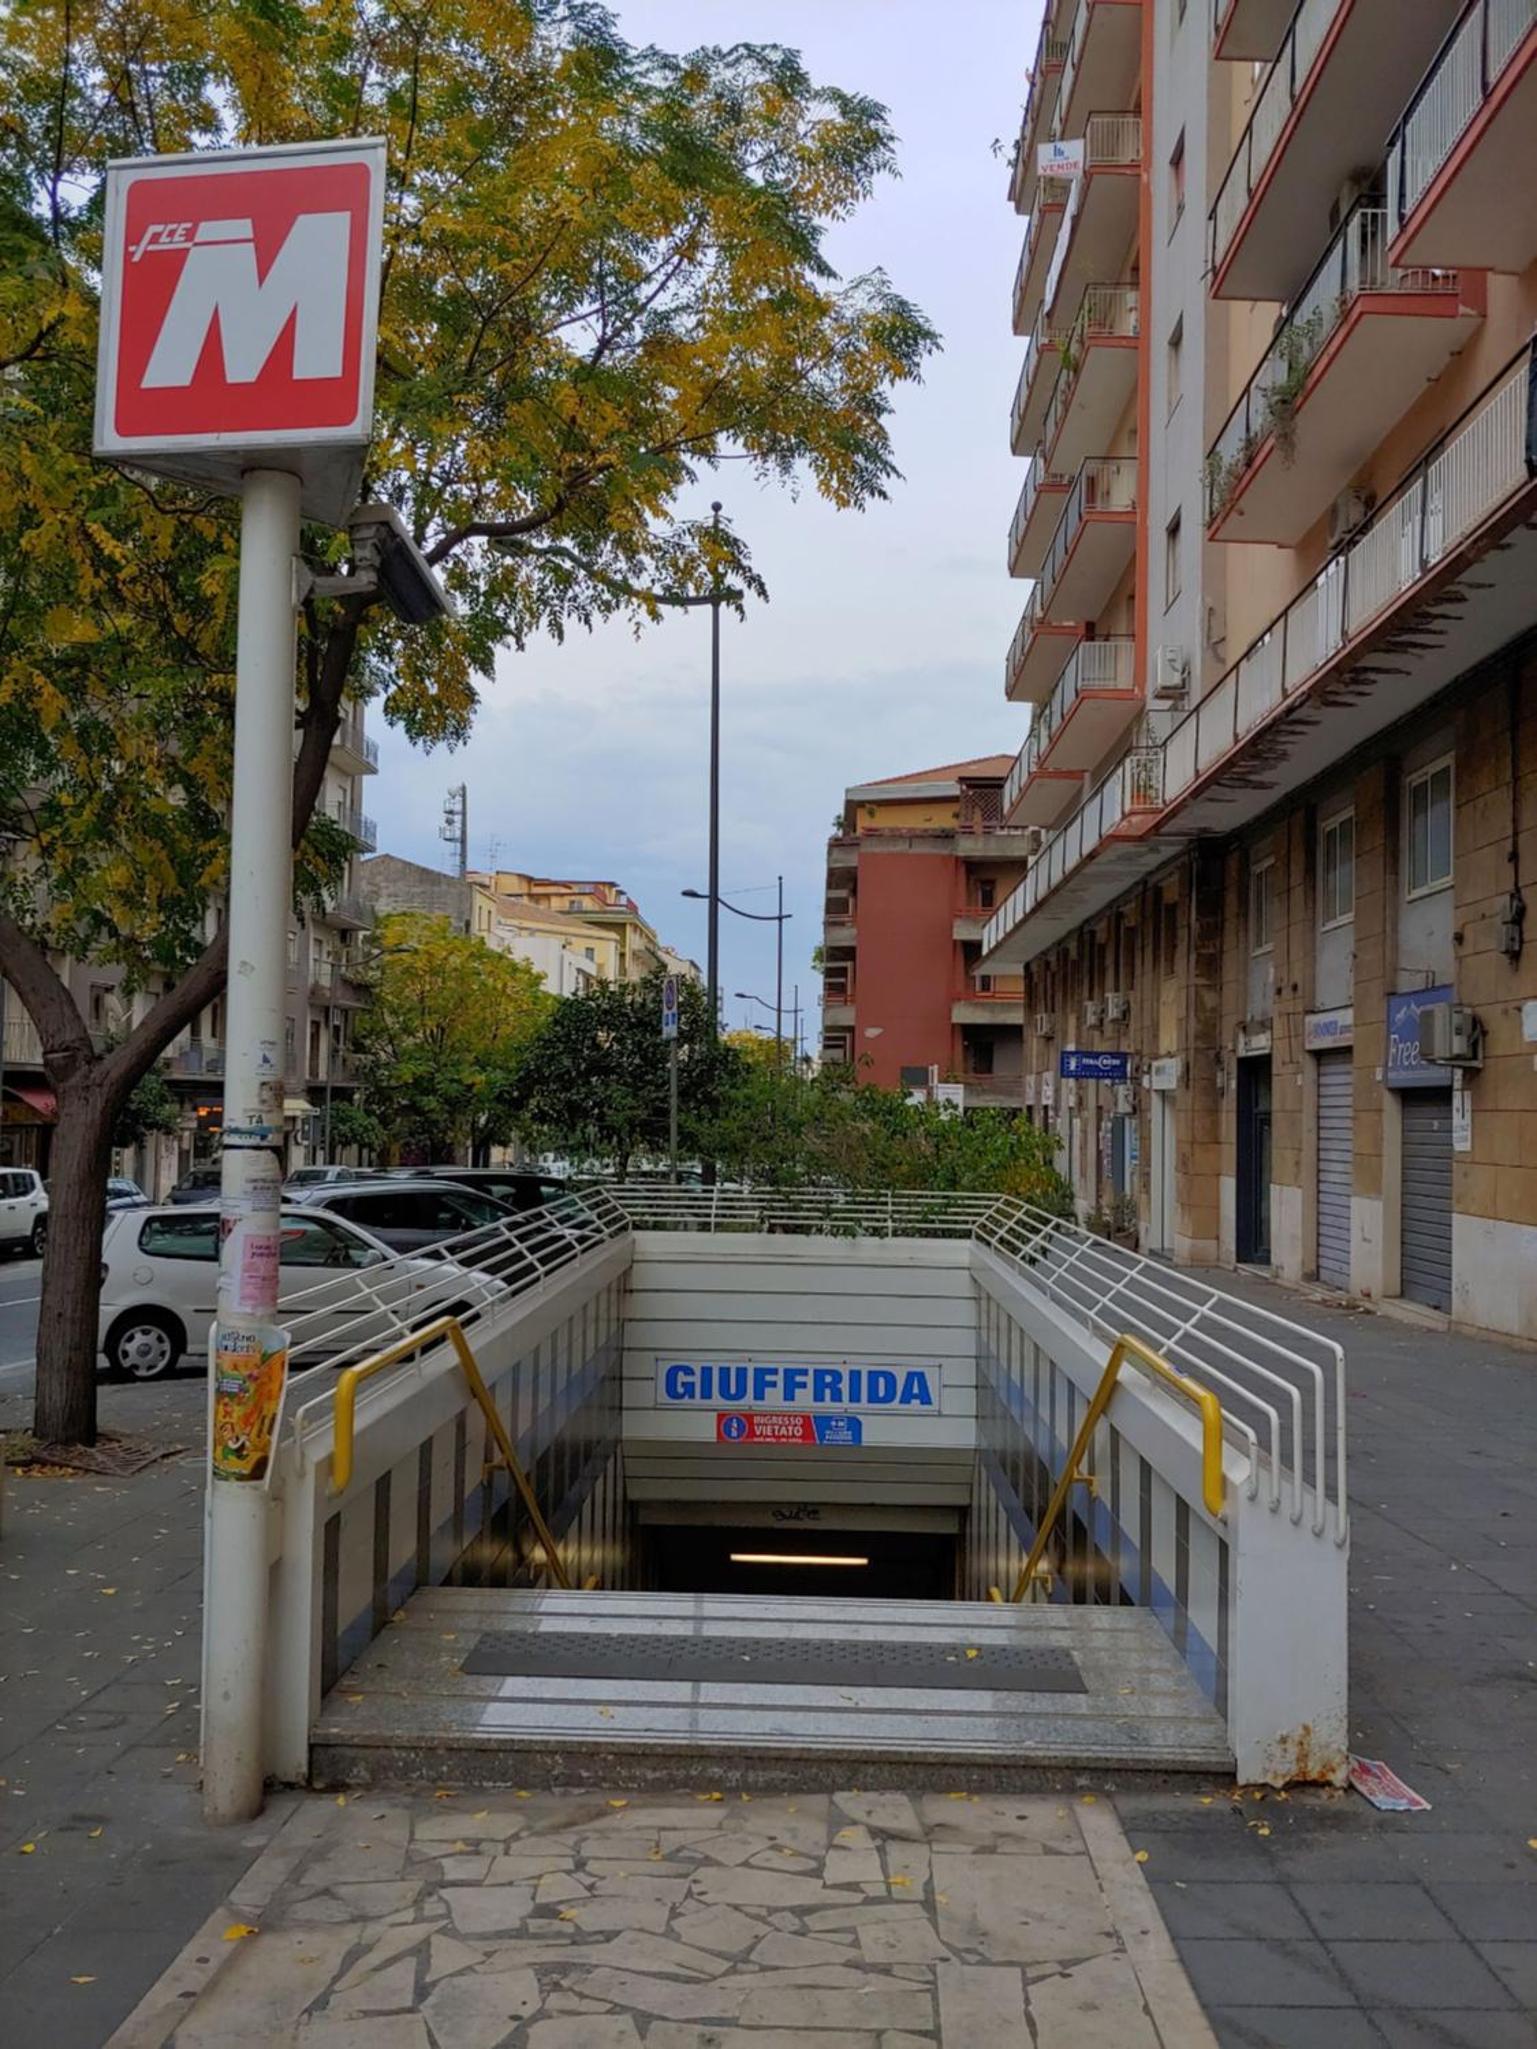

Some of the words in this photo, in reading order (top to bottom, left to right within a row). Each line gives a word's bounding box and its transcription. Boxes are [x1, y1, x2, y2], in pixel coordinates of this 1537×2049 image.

[1041, 161, 1080, 173] VENDE
[140, 210, 352, 389] M
[1388, 1034, 1428, 1067] Free
[664, 1364, 933, 1406] GIUFFRIDA
[753, 1415, 804, 1425] INGRESSO
[753, 1425, 803, 1437] VIETATO
